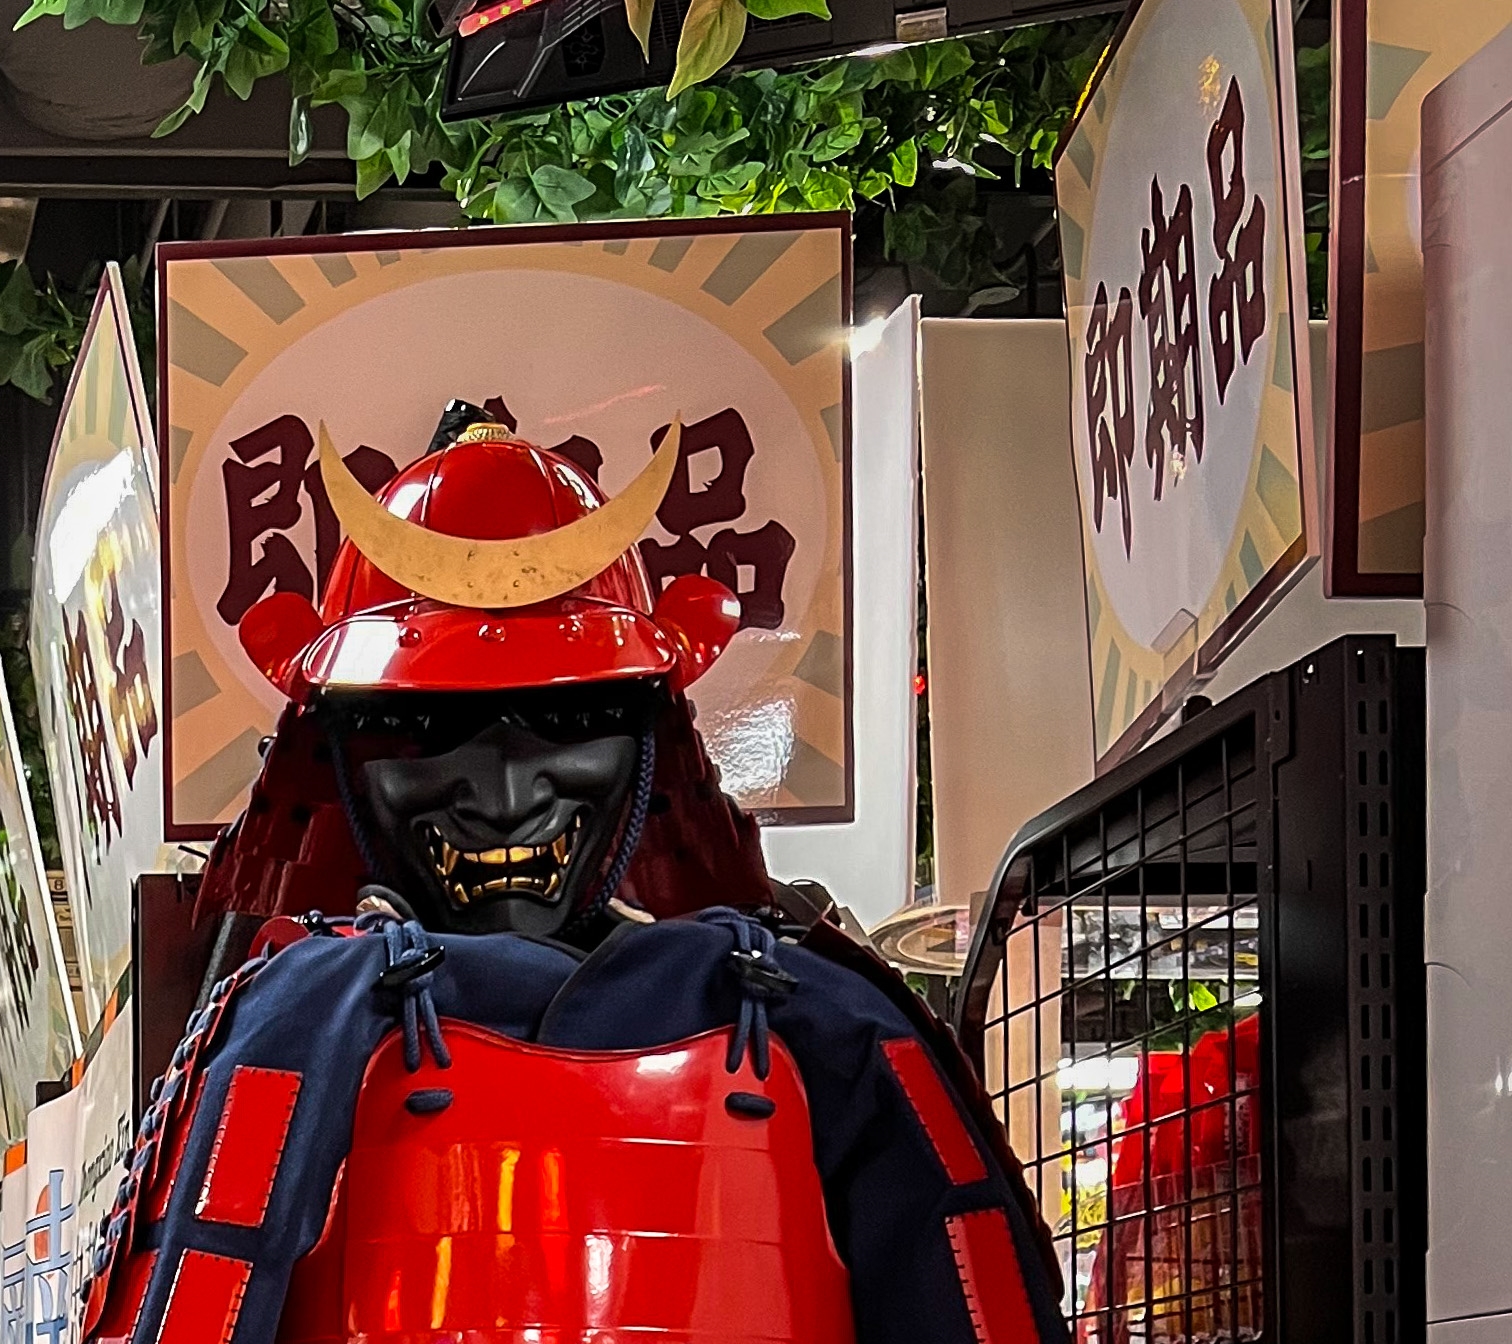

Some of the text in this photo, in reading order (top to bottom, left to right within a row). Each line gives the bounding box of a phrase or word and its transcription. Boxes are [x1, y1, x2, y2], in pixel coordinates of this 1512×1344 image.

[1087, 74, 1267, 563] 即期品
[216, 395, 798, 630] 即品
